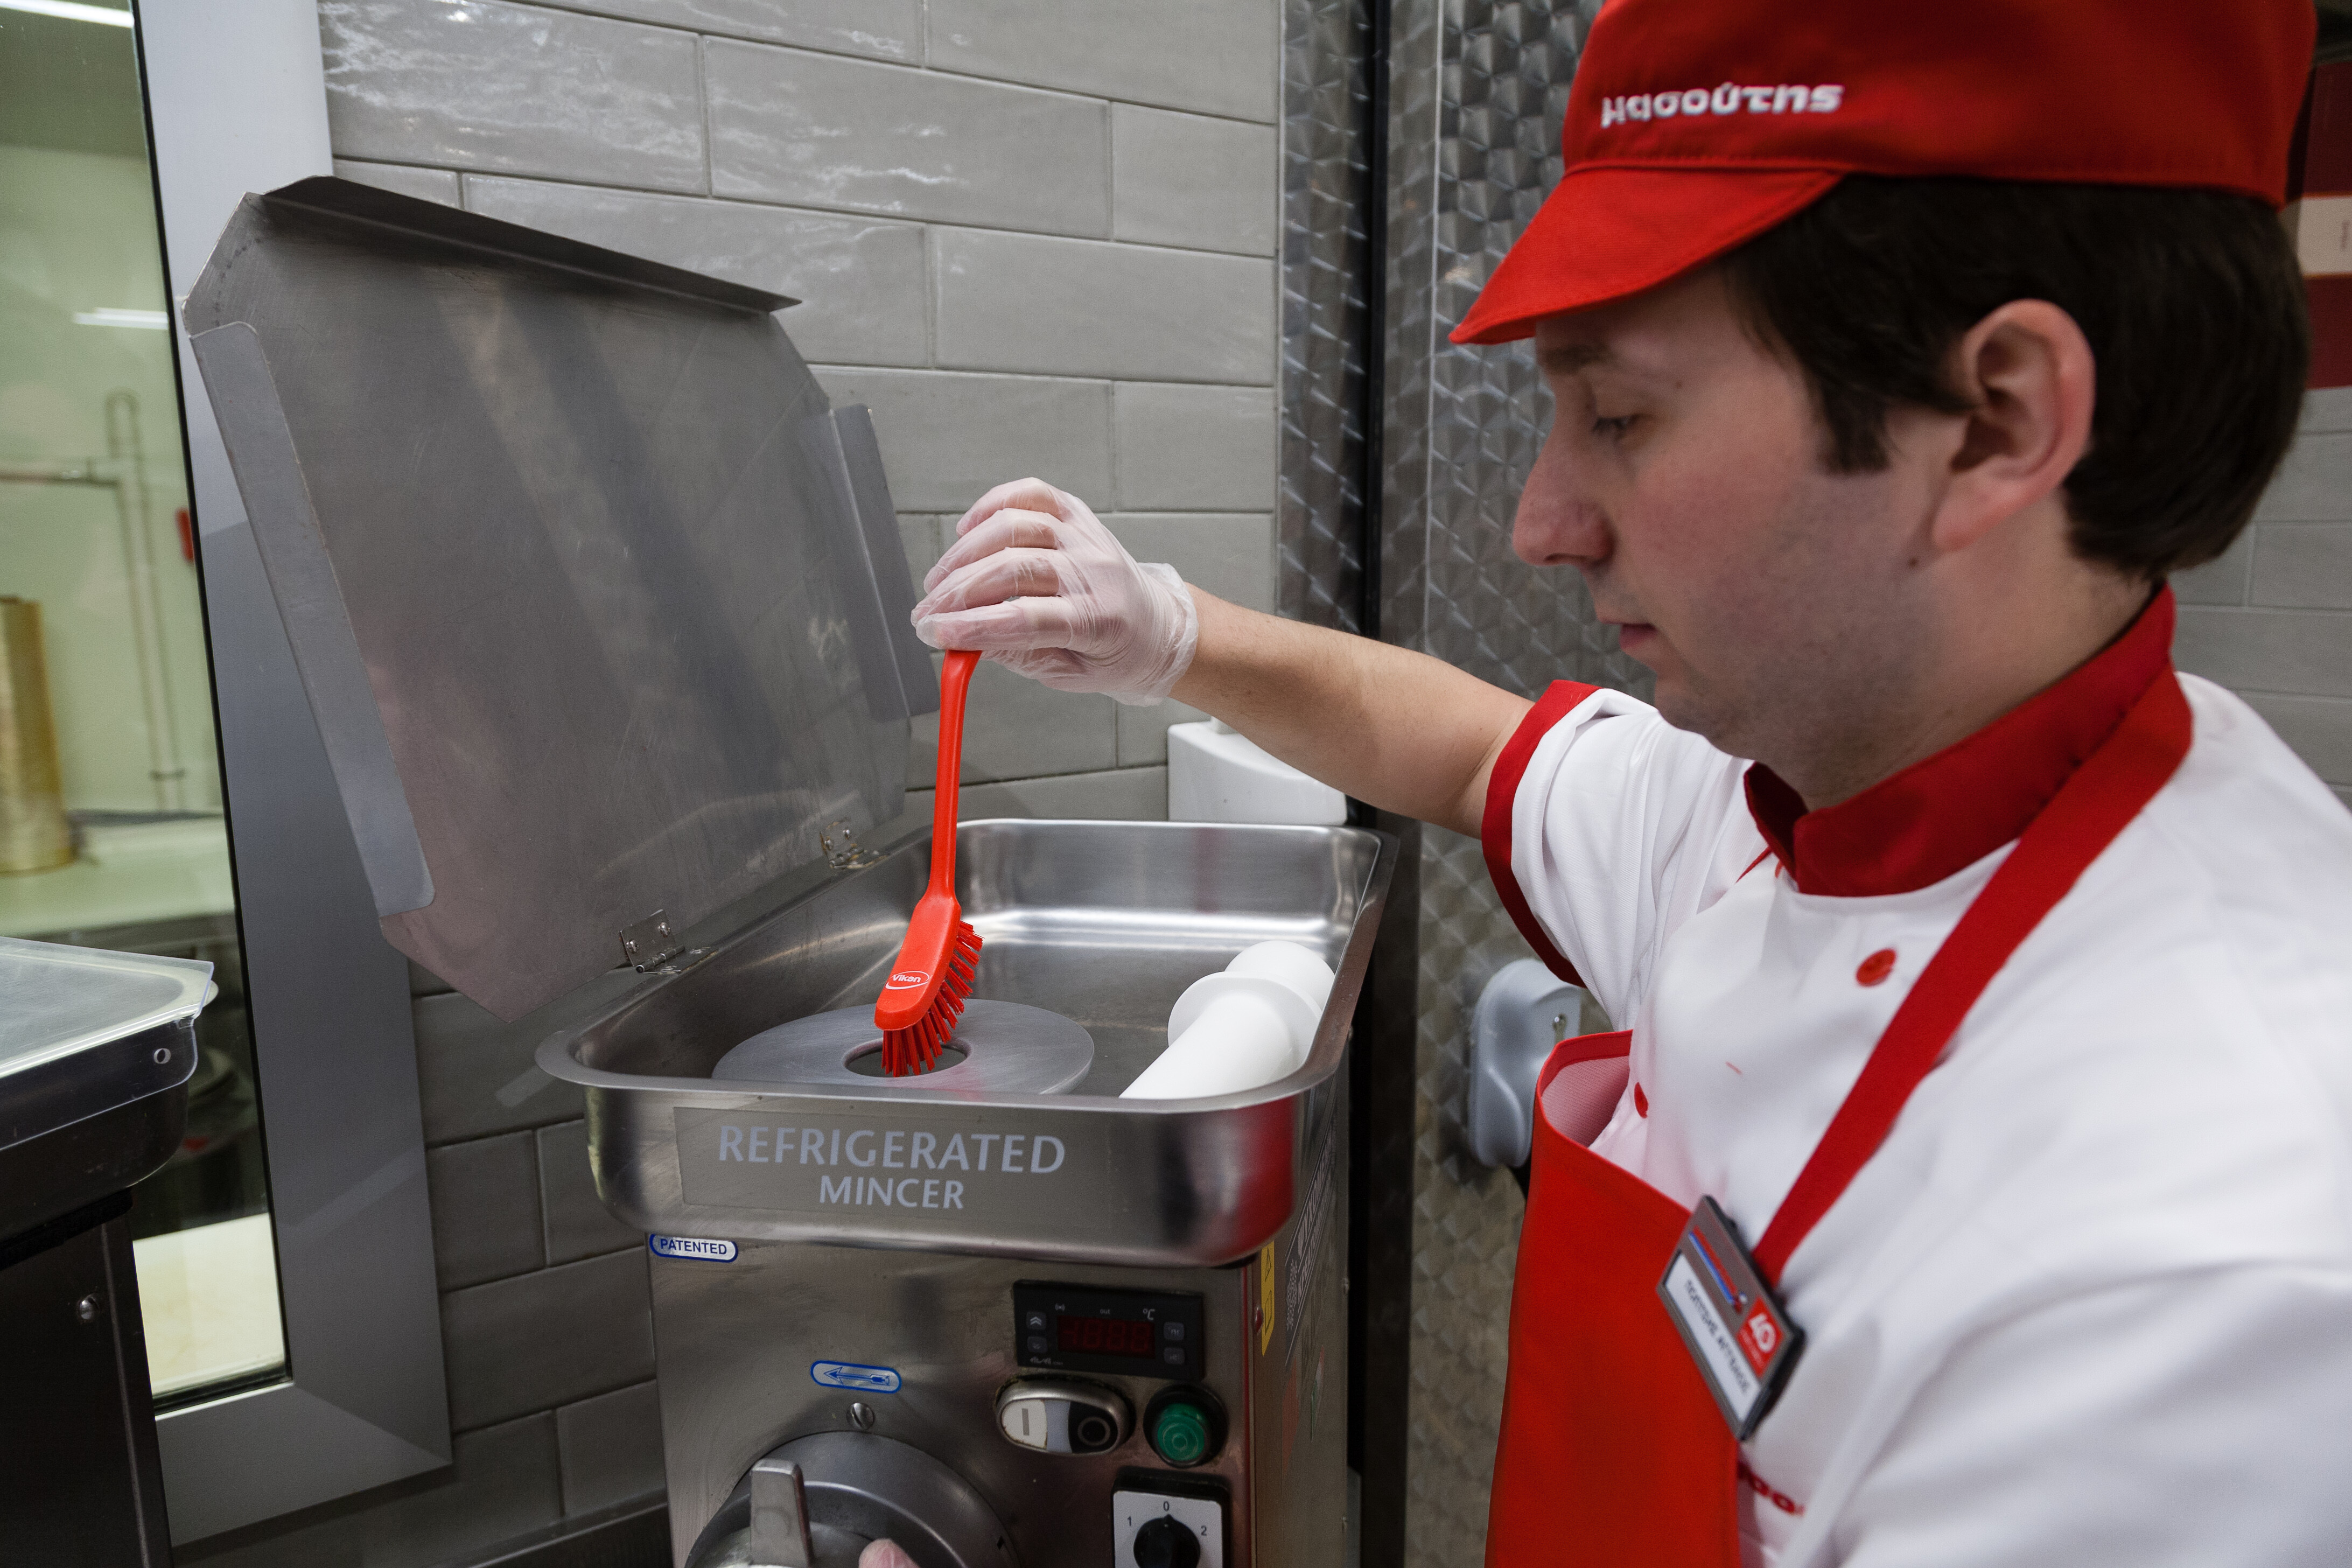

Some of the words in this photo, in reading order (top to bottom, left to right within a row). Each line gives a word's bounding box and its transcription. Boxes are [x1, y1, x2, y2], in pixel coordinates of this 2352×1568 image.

[1600, 81, 1844, 129] μασούτης
[892, 974, 921, 983] Vikan
[718, 1125, 1066, 1174] REFRIGERATED
[818, 1175, 965, 1210] MINCER
[660, 1238, 727, 1255] PATENTED
[1163, 1501, 1170, 1511] 0
[1126, 1516, 1132, 1527] 1
[1200, 1525, 1207, 1536] 2
